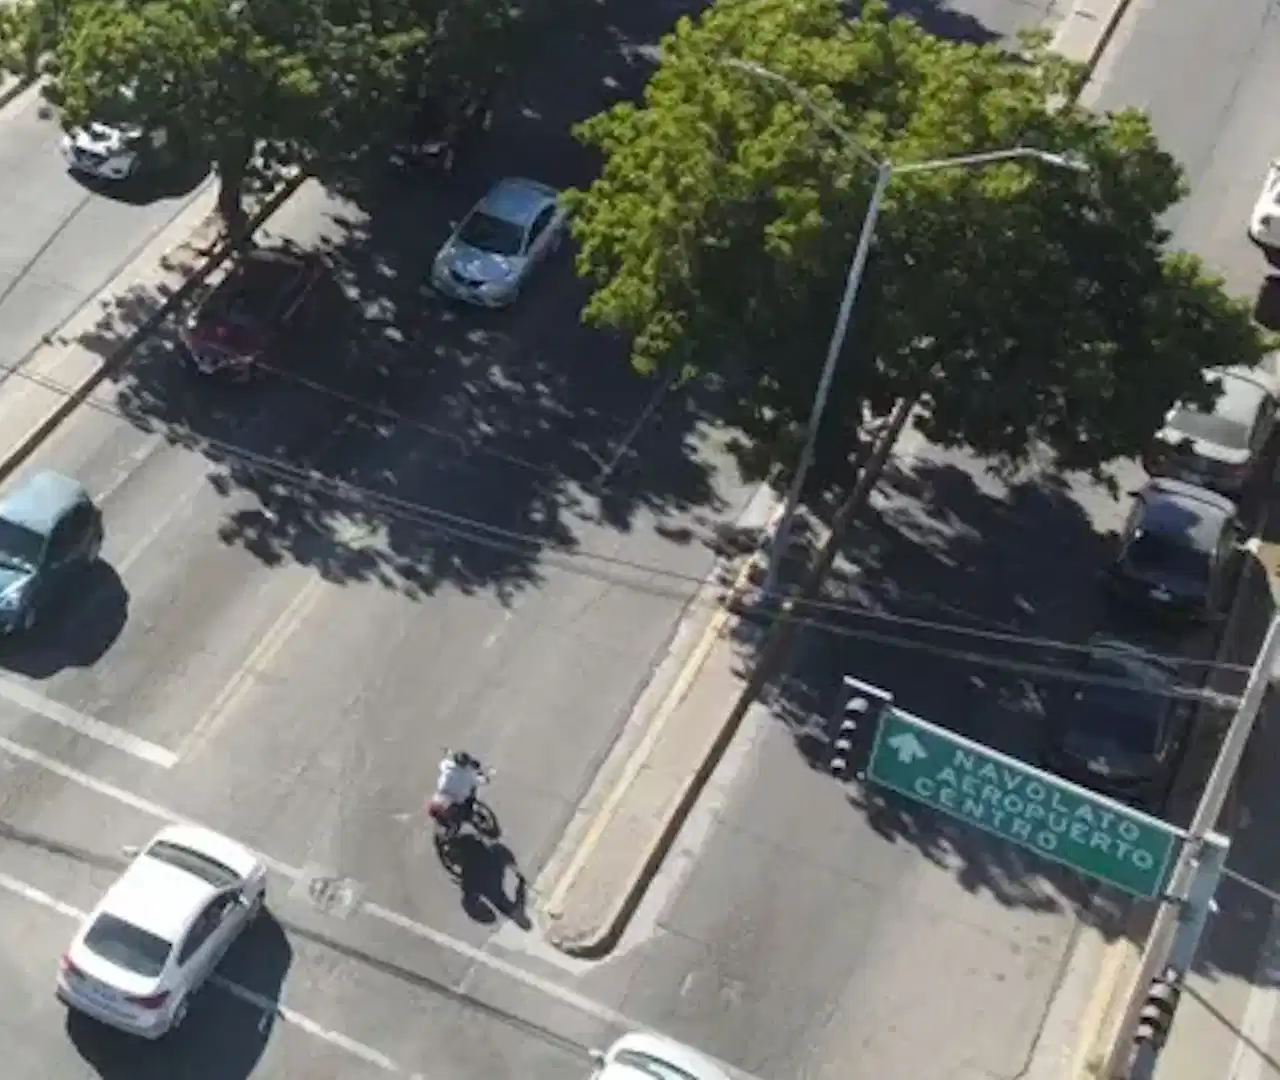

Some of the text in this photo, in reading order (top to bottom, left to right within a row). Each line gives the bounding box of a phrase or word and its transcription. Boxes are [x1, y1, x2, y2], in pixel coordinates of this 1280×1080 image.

[913, 777, 1058, 852] CENTRO
[936, 768, 1155, 871] AEROPUERTO
[952, 748, 1140, 842] NAVOLATO
